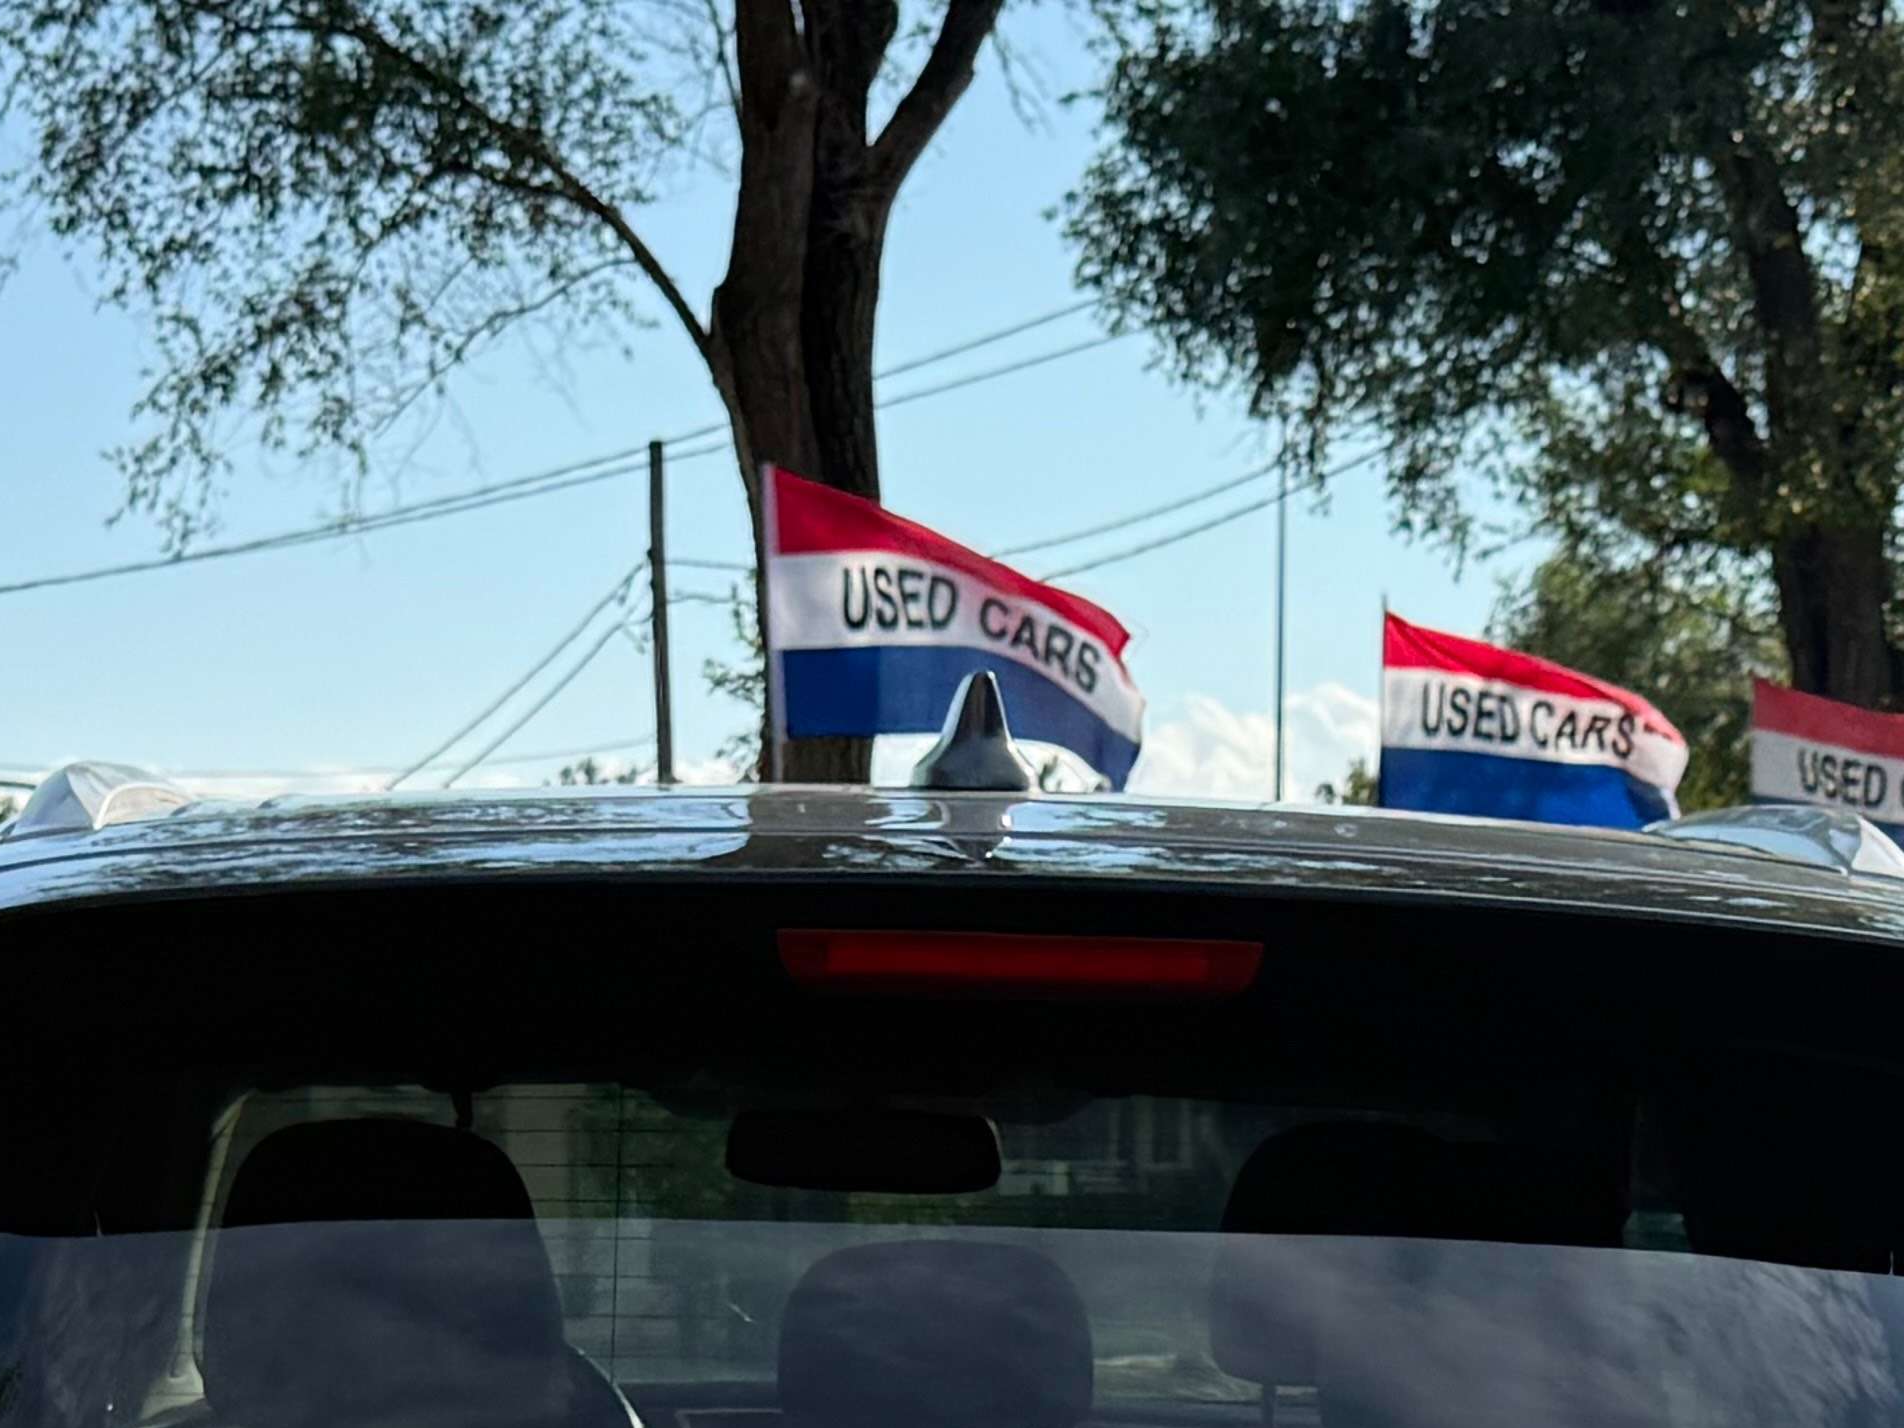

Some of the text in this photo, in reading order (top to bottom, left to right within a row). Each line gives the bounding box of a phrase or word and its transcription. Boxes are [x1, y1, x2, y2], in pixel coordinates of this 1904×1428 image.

[843, 567, 1101, 694] USED CARS
[1422, 683, 1636, 760] USED CARS
[1798, 748, 1888, 809] USED
